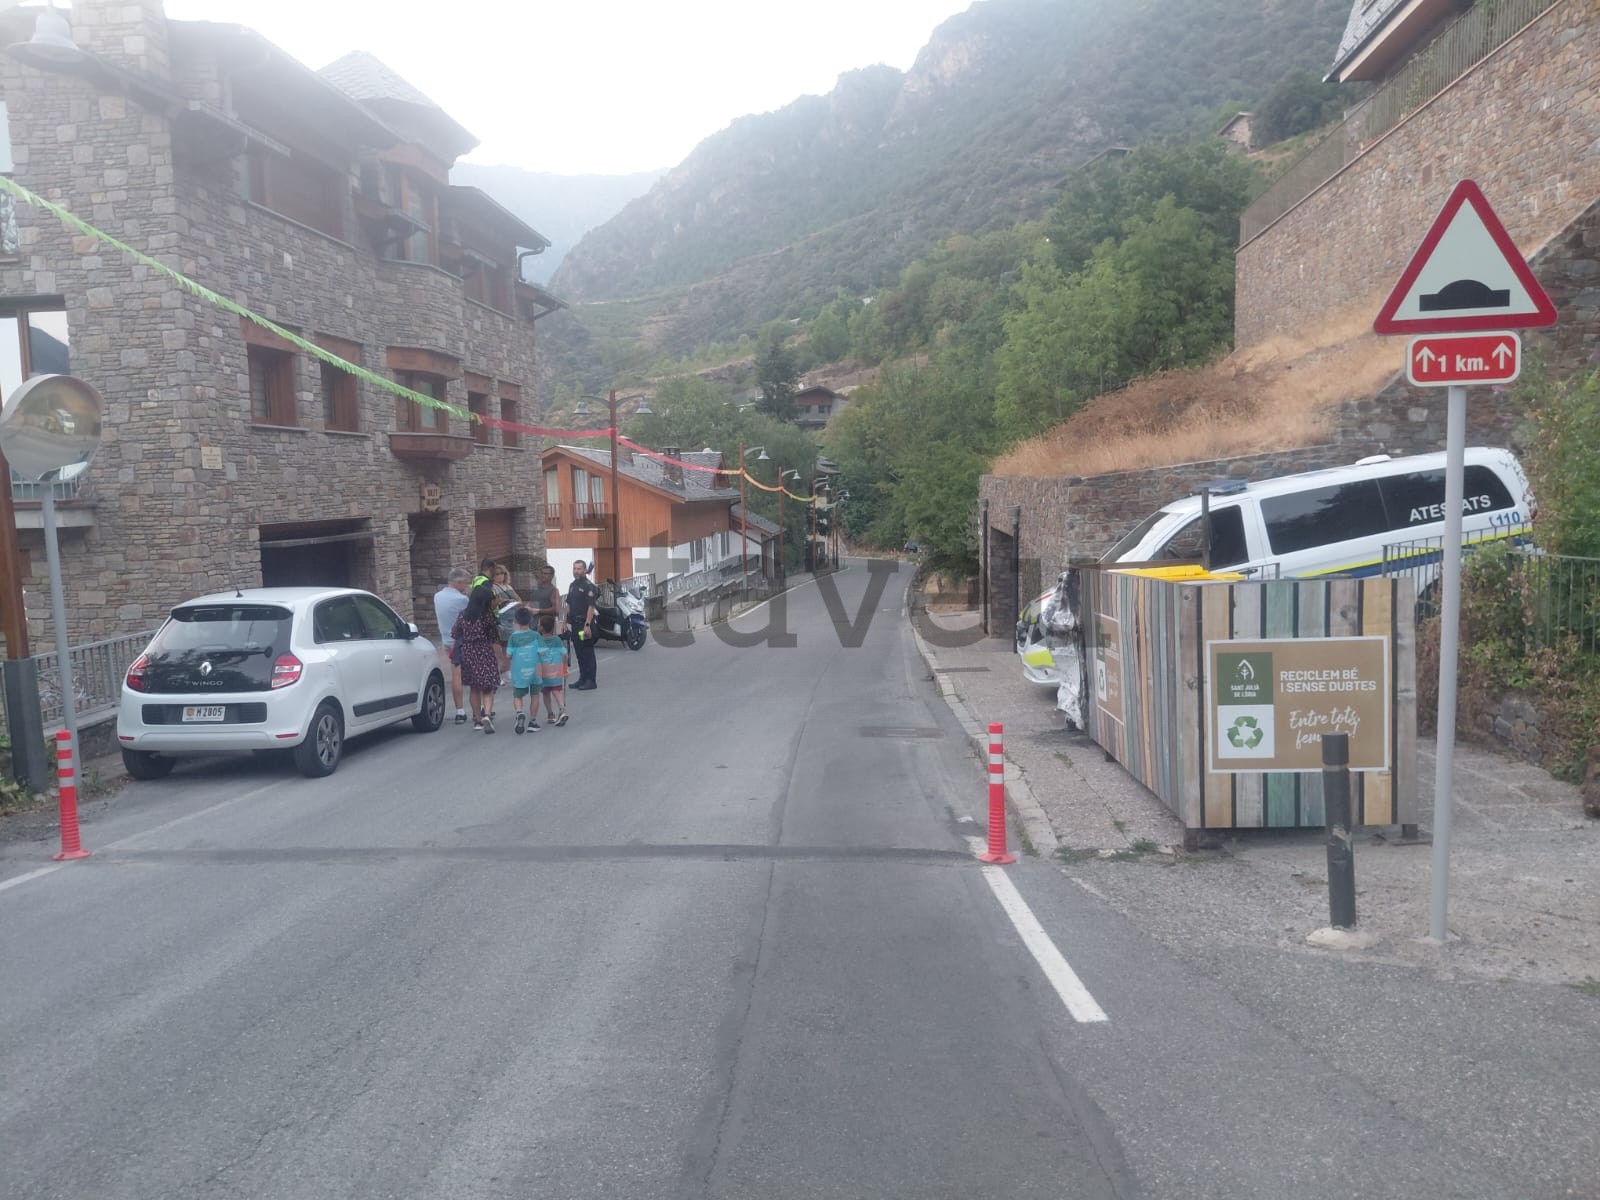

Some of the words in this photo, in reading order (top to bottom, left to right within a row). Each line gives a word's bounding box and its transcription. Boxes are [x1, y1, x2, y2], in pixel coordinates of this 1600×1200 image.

[1437, 354, 1447, 373] 1
[1455, 354, 1490, 372] km.
[1409, 494, 1492, 522] ATESATS
[1496, 511, 1520, 527] 110
[1280, 669, 1340, 681] RECICLEM
[1342, 667, 1359, 680] BÉ
[1280, 682, 1284, 693] I
[1286, 681, 1327, 692] SENSE
[1328, 680, 1377, 692] DUBTES
[1289, 710, 1328, 729] Entre
